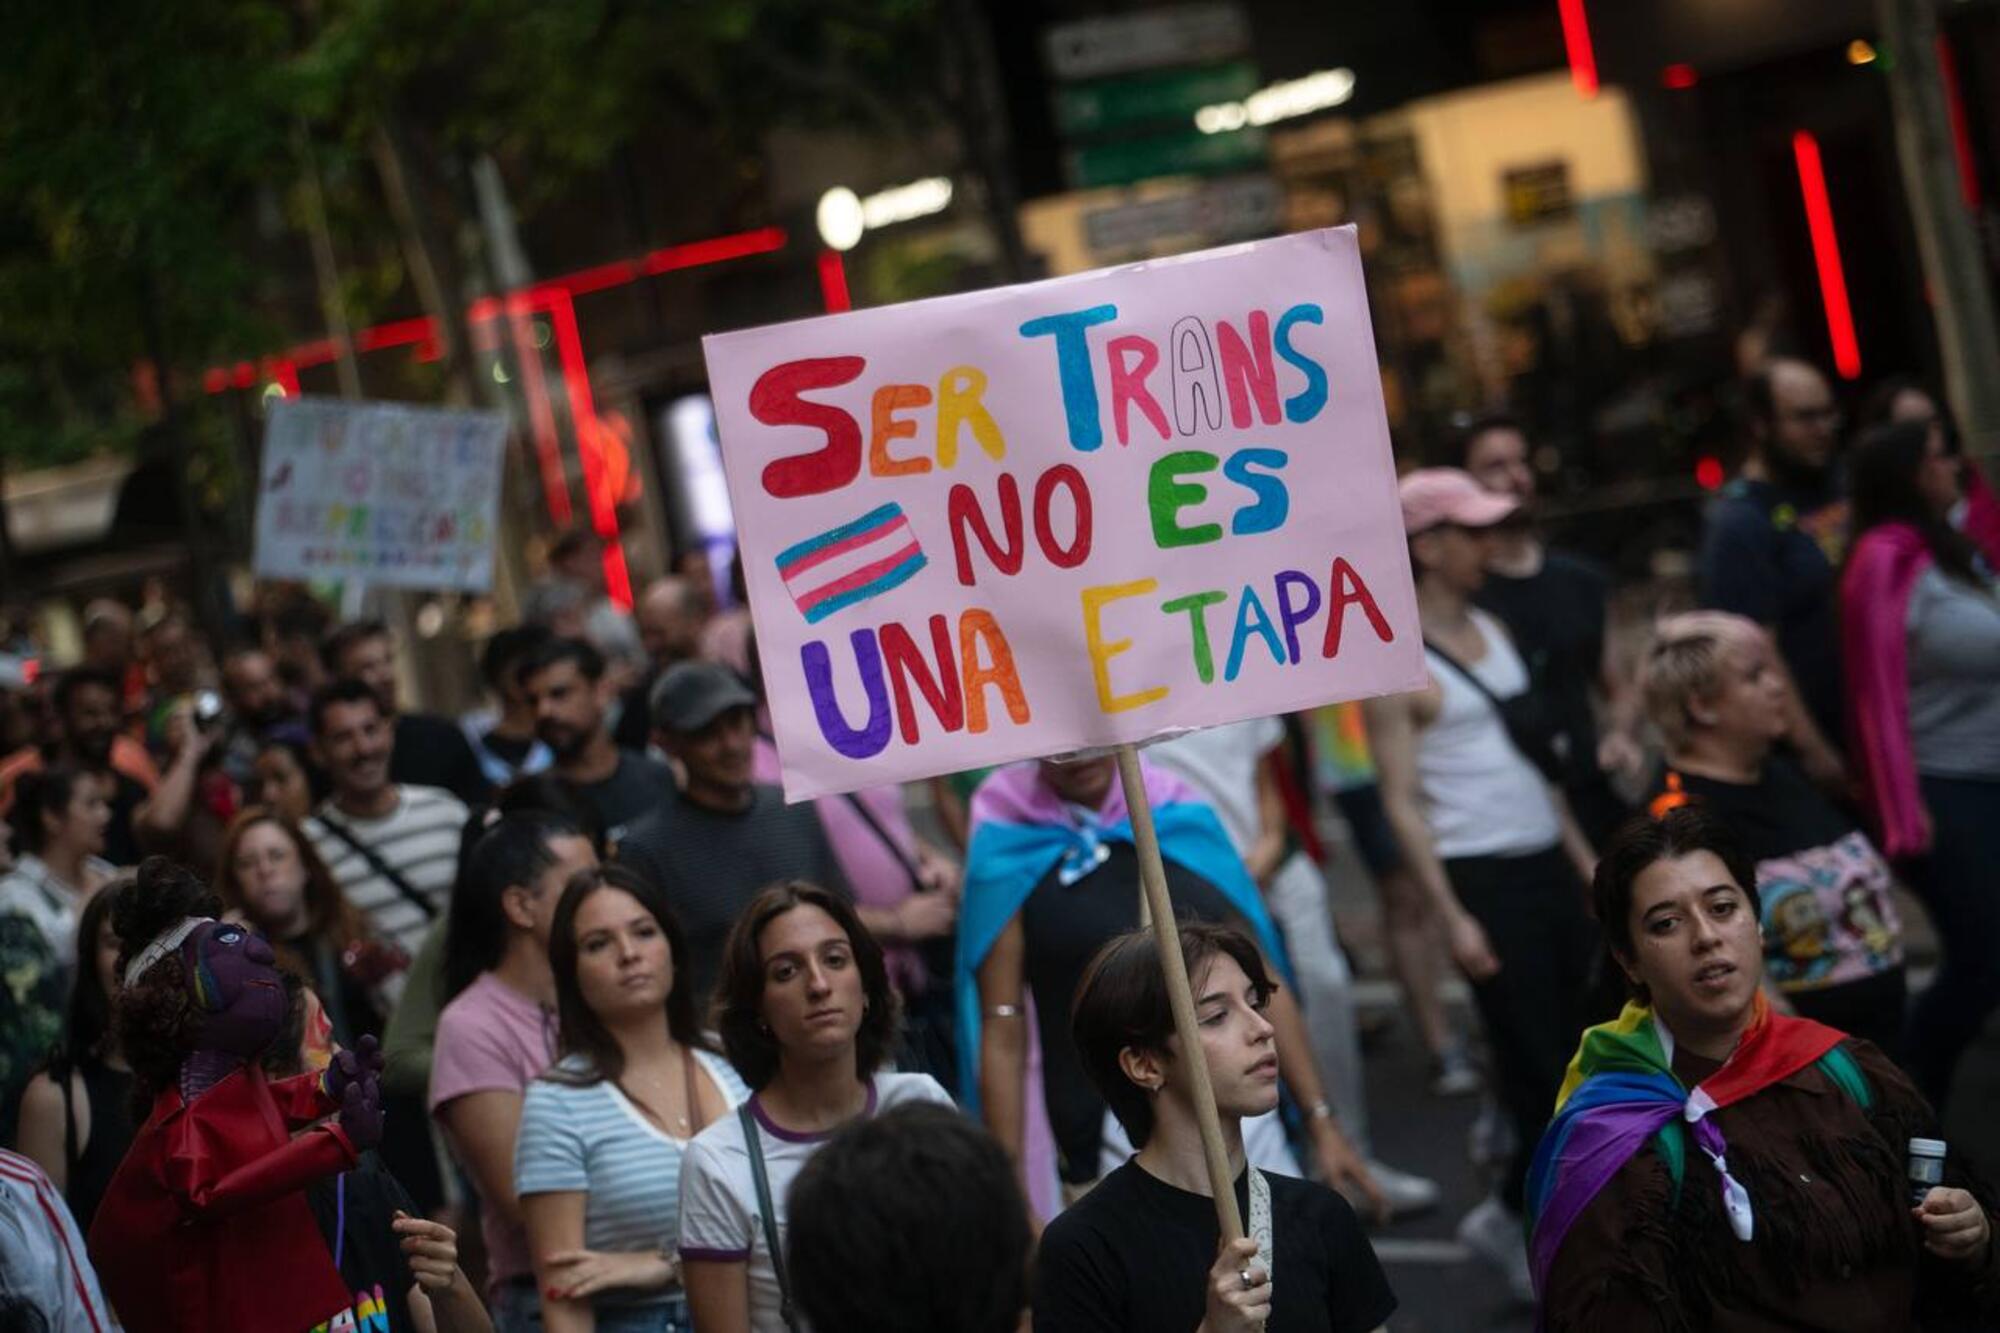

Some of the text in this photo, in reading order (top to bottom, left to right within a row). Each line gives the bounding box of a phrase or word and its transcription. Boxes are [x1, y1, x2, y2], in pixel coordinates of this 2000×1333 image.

[749, 303, 1329, 499] SER TRANS
[948, 447, 1290, 586] NO ES
[800, 558, 1393, 761] UNA ETAPA
